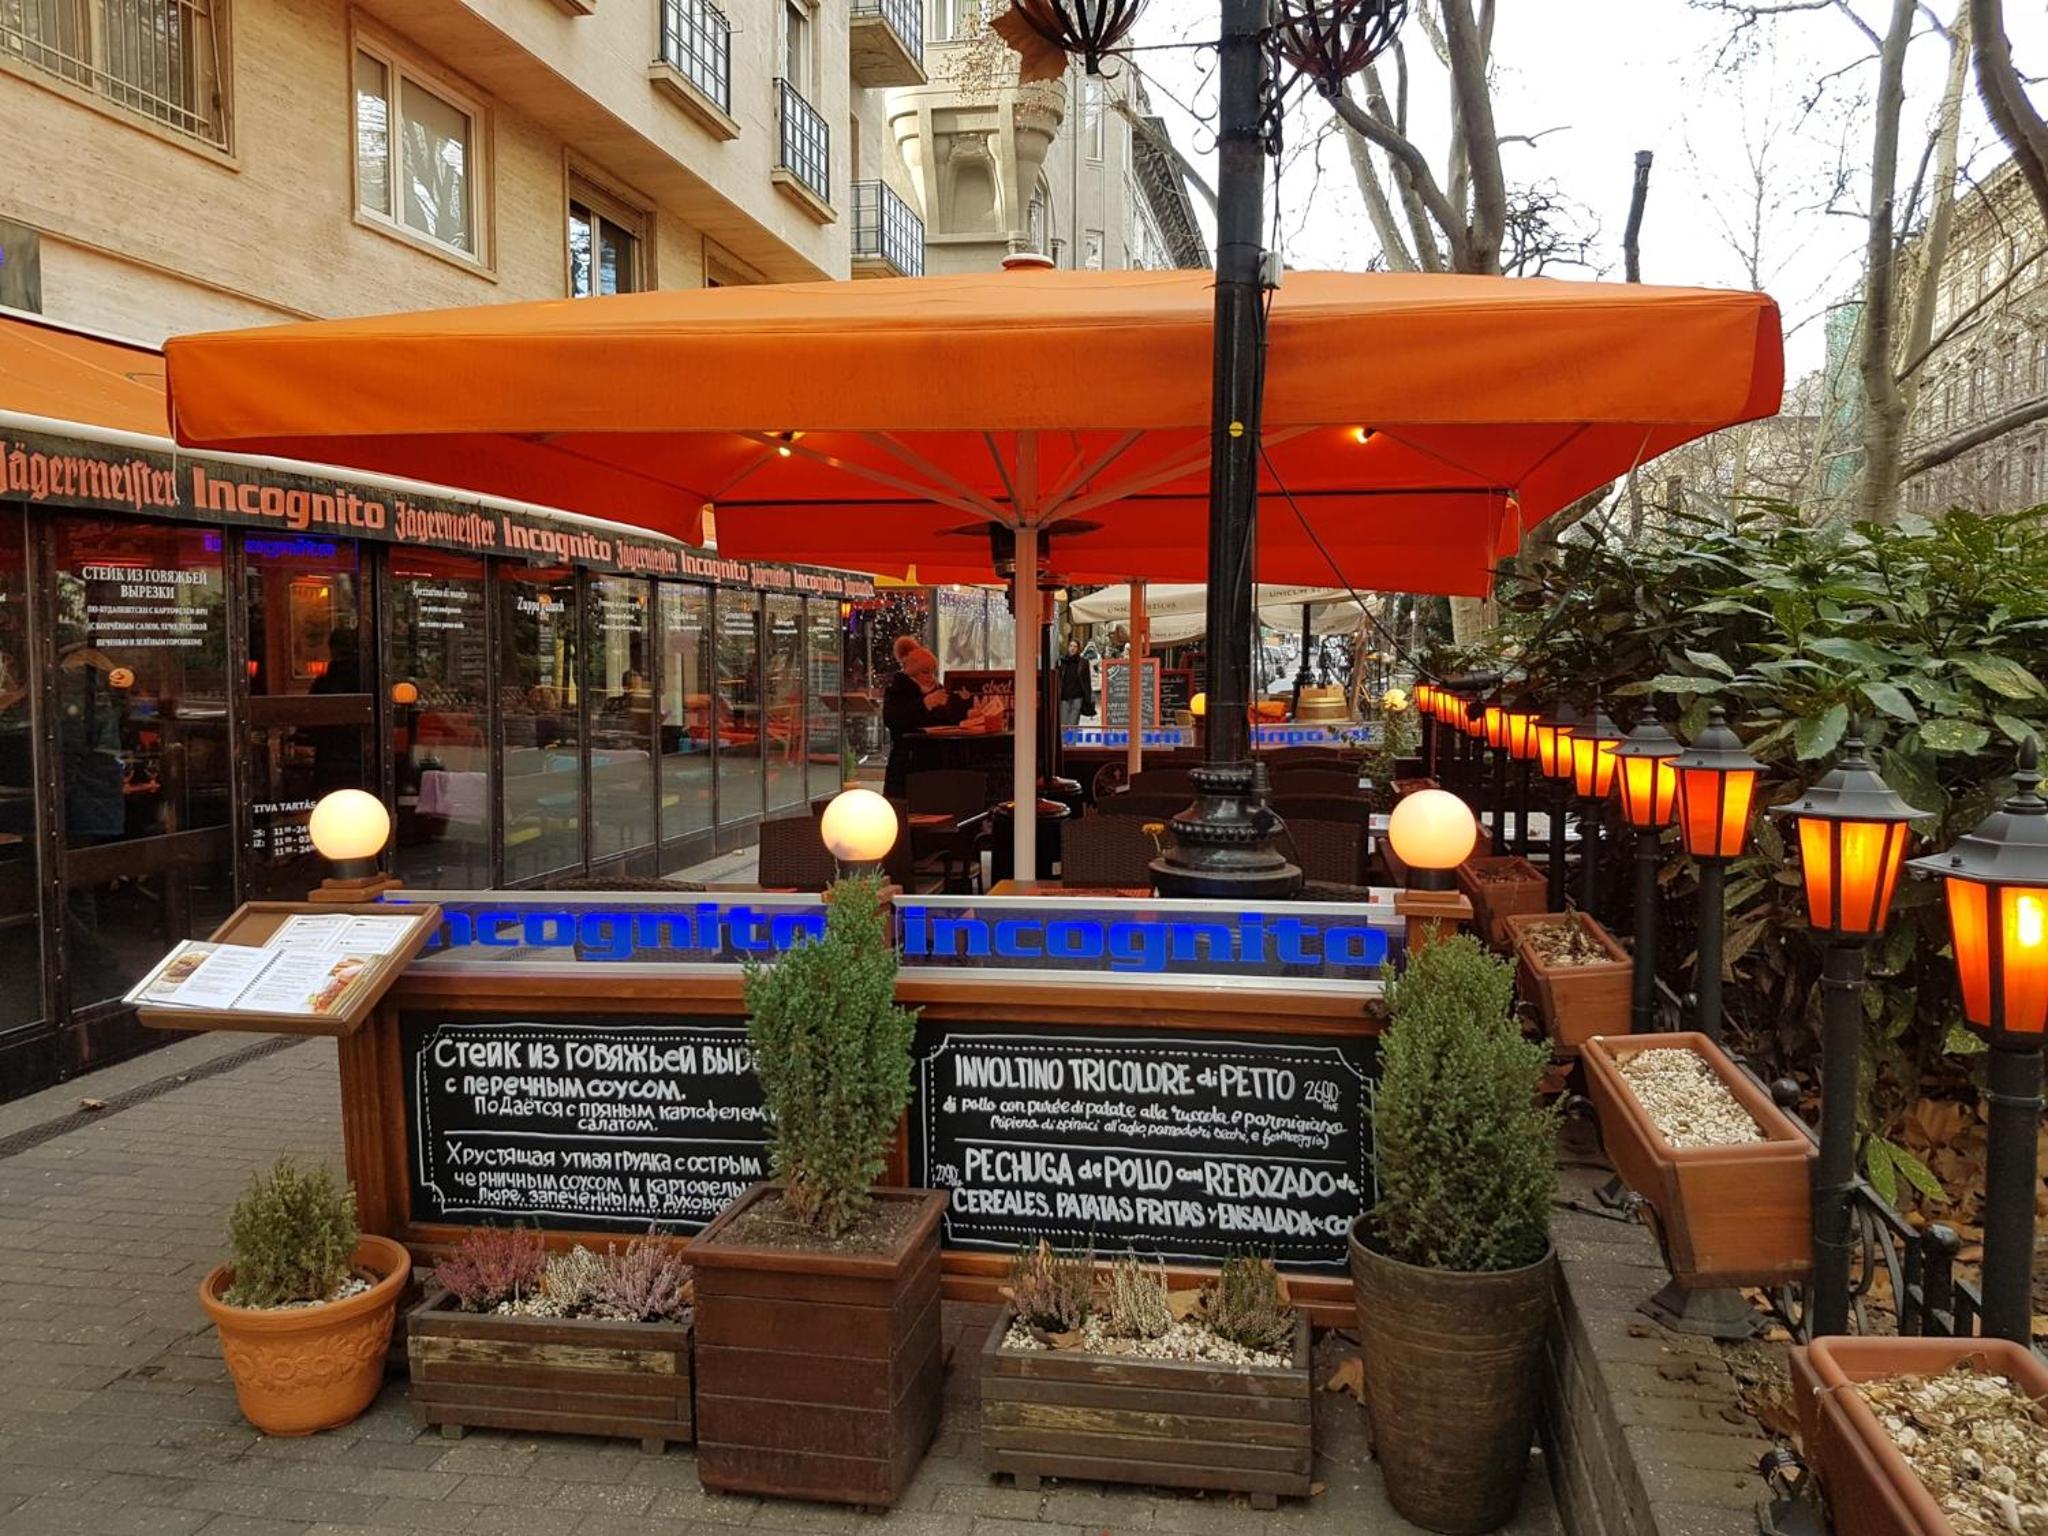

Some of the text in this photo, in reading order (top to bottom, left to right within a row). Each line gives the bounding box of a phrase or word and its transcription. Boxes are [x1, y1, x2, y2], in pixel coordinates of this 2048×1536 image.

[192, 466, 385, 529] Incognito
[395, 500, 497, 549] Jägermeister
[504, 517, 612, 562] Incognito
[682, 550, 748, 583] Incognito
[794, 569, 842, 592] Incognito
[82, 566, 207, 585] СТЕЙК ИЗ ГОВЯЖЬЕЙ
[121, 585, 175, 598] ВЫРЕЗКИ
[374, 896, 828, 961] ncognito
[903, 905, 1388, 972] incognito
[528, 1042, 560, 1069] из
[445, 1075, 686, 1101] с перечным соусом.
[955, 1054, 1064, 1090] INVOLTINO
[1068, 1058, 1195, 1096] TRICOLORE
[1196, 1067, 1218, 1087] di
[1219, 1064, 1296, 1100] PETTO
[566, 1104, 577, 1116] с
[579, 1102, 656, 1119] пряным
[659, 1099, 767, 1122] картофелем
[962, 1097, 996, 1112] pollo
[1000, 1101, 1026, 1114] con
[1071, 1101, 1084, 1114] di
[1086, 1101, 1136, 1119] patate
[1140, 1103, 1169, 1121] alla
[1231, 1111, 1242, 1123] e
[1244, 1113, 1348, 1135] parmigiano
[578, 1117, 658, 1133] салатом.
[1041, 1119, 1055, 1131] di
[1056, 1118, 1100, 1133] spinaci
[1148, 1123, 1211, 1139] pomodori
[1251, 1132, 1259, 1141] e
[446, 1140, 555, 1167] Хрустящая
[614, 1150, 672, 1173] грудка
[674, 1157, 685, 1170] с
[687, 1154, 762, 1176] острым
[454, 1171, 558, 1190] черничным
[559, 1174, 623, 1194] соусом
[629, 1177, 640, 1193] и
[965, 1147, 1075, 1186] PECHUGA
[1078, 1159, 1102, 1180] de
[1104, 1155, 1173, 1191] POLLO
[1176, 1168, 1203, 1183] con
[1203, 1160, 1337, 1200] REBOZADO
[1336, 1173, 1360, 1195] de
[650, 1193, 659, 1209] в
[1056, 1192, 1136, 1223] PATATAS
[1136, 1198, 1206, 1227] FRITAS
[1218, 1202, 1317, 1237] ENSALADA
